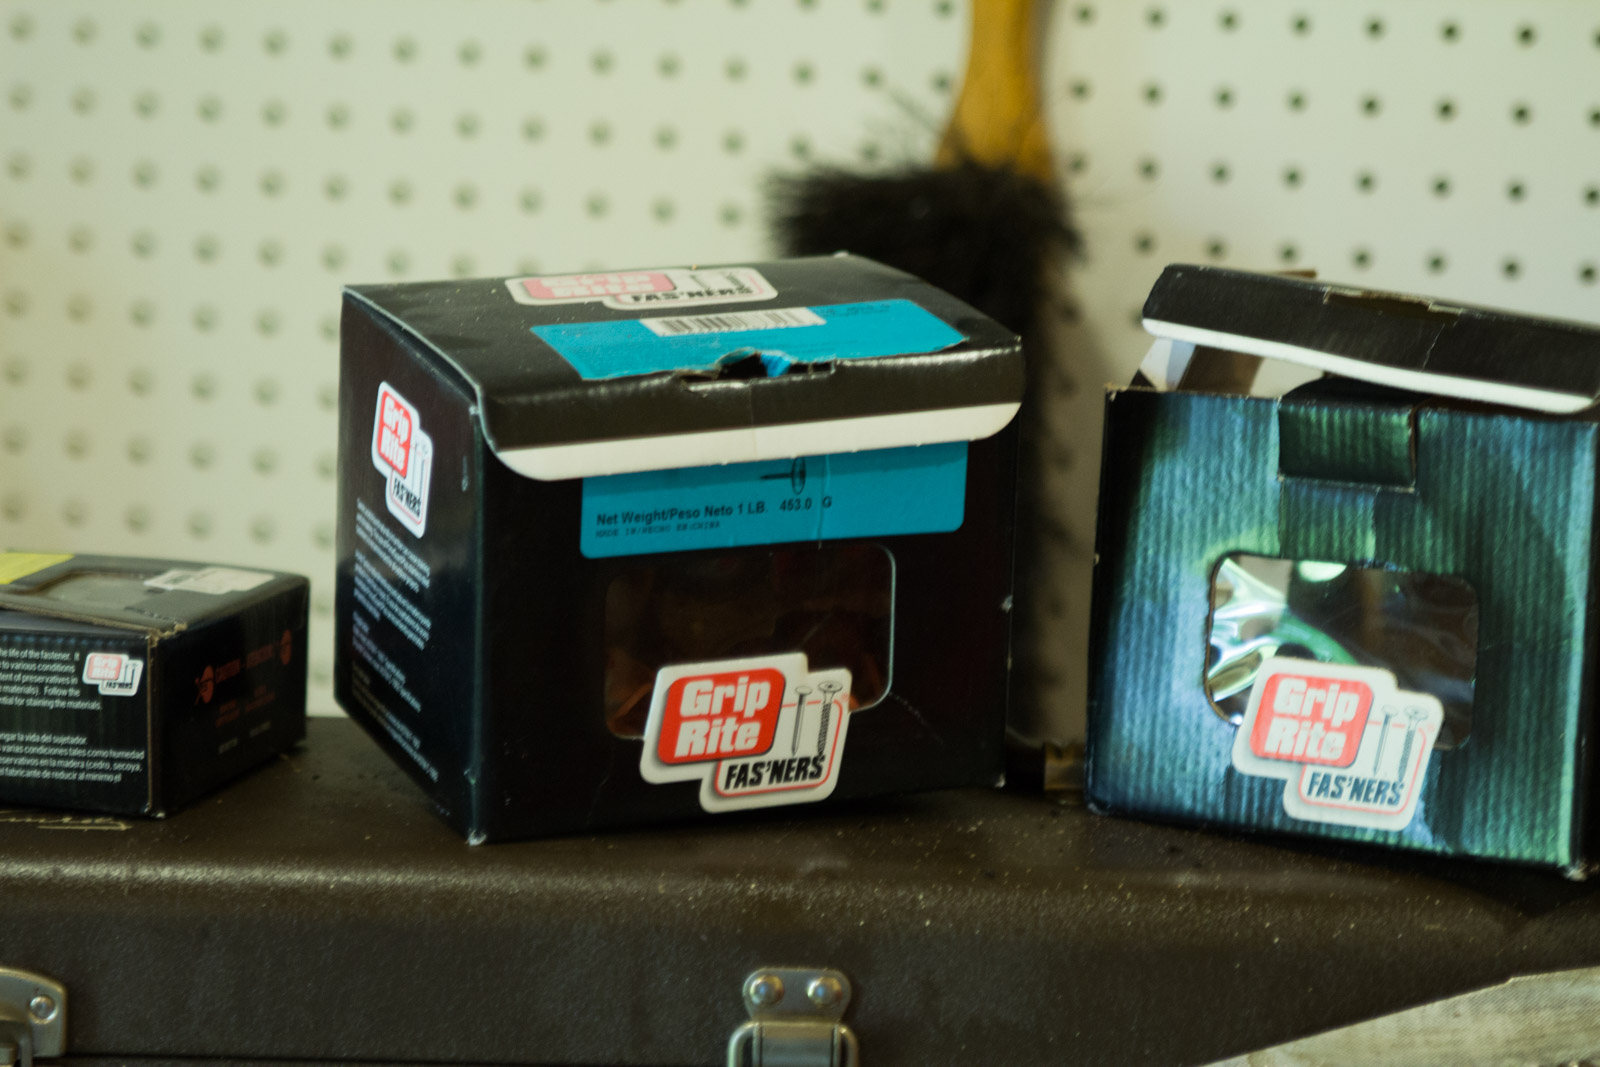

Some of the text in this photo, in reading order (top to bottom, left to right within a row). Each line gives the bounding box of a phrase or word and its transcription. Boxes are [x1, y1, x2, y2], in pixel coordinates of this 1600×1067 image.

[383, 395, 410, 446] Grip
[380, 424, 407, 472] Rite
[596, 512, 619, 526] Net
[622, 508, 701, 525] Weight/Peso
[704, 505, 734, 518] Neto
[737, 504, 743, 515] 1
[778, 497, 813, 513] 453.0
[20, 649, 28, 659] of
[28, 649, 40, 659] the
[10, 662, 37, 671] various
[13, 673, 21, 682] of
[22, 674, 70, 685] preservatives
[14, 697, 25, 706] for
[26, 697, 54, 709] staining
[54, 699, 67, 708] the
[44, 686, 67, 697] Follow
[68, 688, 80, 698] the
[680, 675, 772, 720] Grip
[1273, 677, 1360, 727] Grip
[17, 733, 24, 742] la
[25, 733, 40, 743] vida
[40, 734, 52, 744] del
[673, 717, 762, 759] Rite
[1264, 717, 1348, 761] Rite
[2, 745, 145, 760] varias condiciones tales como humedad
[39, 757, 49, 767] en
[49, 757, 56, 767] la
[57, 758, 85, 769] madera
[5, 767, 41, 778] fabricante
[41, 769, 51, 779] de
[51, 770, 77, 780] reducir
[77, 771, 85, 781] al
[723, 755, 827, 791] FAS'NERS
[1306, 771, 1406, 807] FAS'NERS
